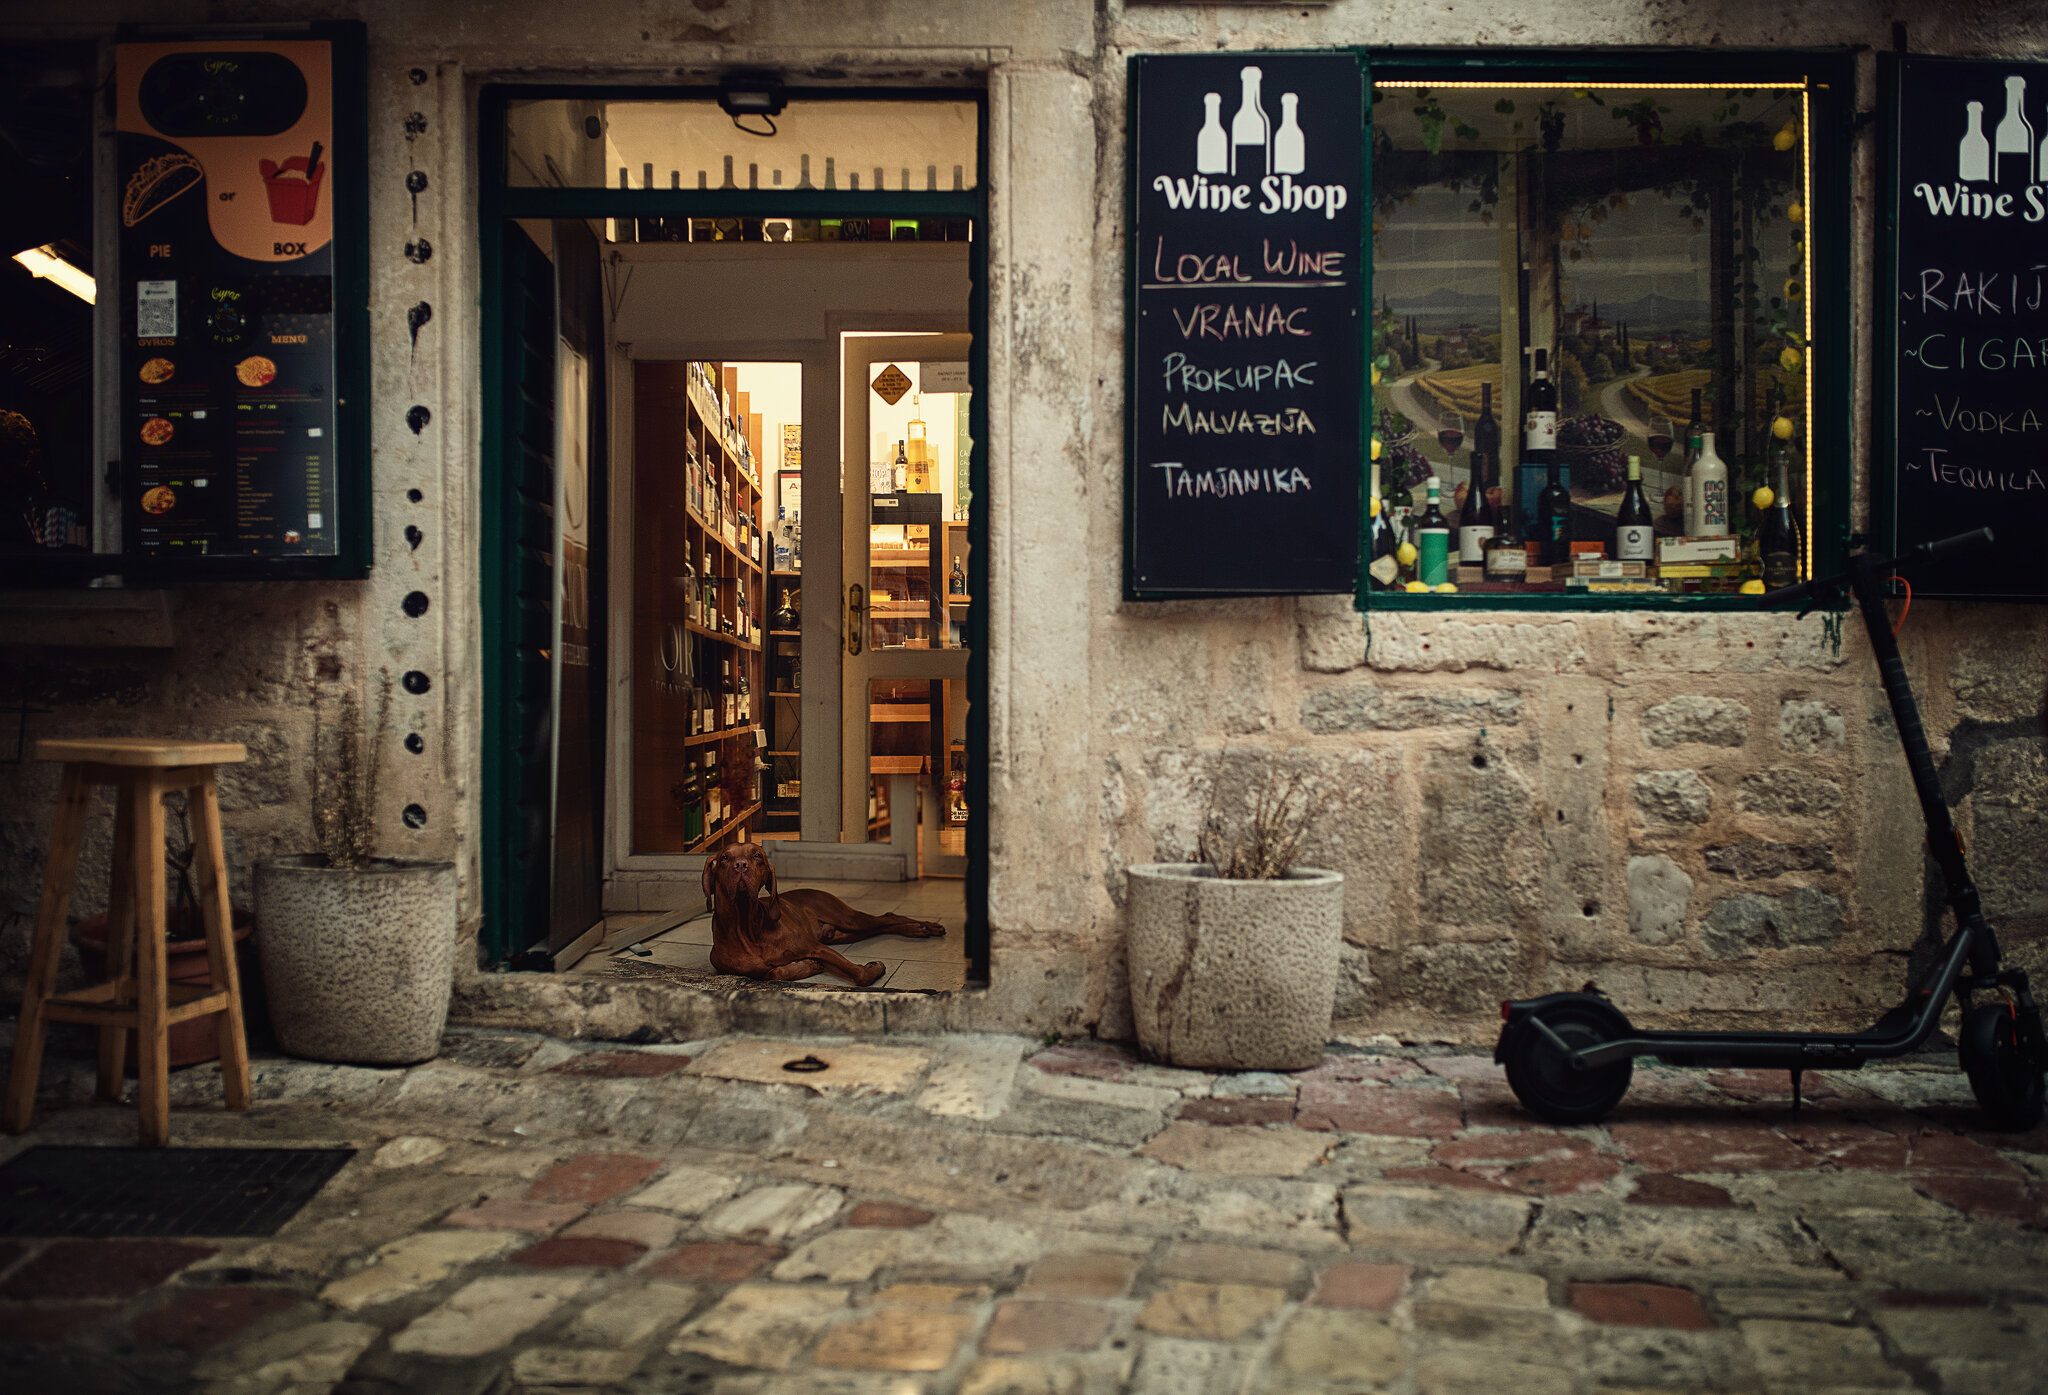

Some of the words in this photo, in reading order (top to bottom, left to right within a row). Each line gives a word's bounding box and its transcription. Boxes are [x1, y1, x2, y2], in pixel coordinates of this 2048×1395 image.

[219, 191, 236, 202] or
[1153, 174, 1251, 213] Wine
[1259, 174, 1348, 220] Shop
[1913, 182, 2014, 220] Wine
[149, 243, 172, 258] PIE
[273, 242, 307, 256] BOX
[1155, 235, 1253, 283] LOCAL
[1263, 238, 1347, 277] WINE
[271, 333, 307, 344] MENU
[1172, 303, 1312, 342] VRANAC
[137, 337, 176, 347] GYROS
[1162, 351, 1318, 393] PROKUPAC
[1162, 401, 1317, 436] MALVAZIJA
[1149, 461, 1312, 498] TAMJANIKA
